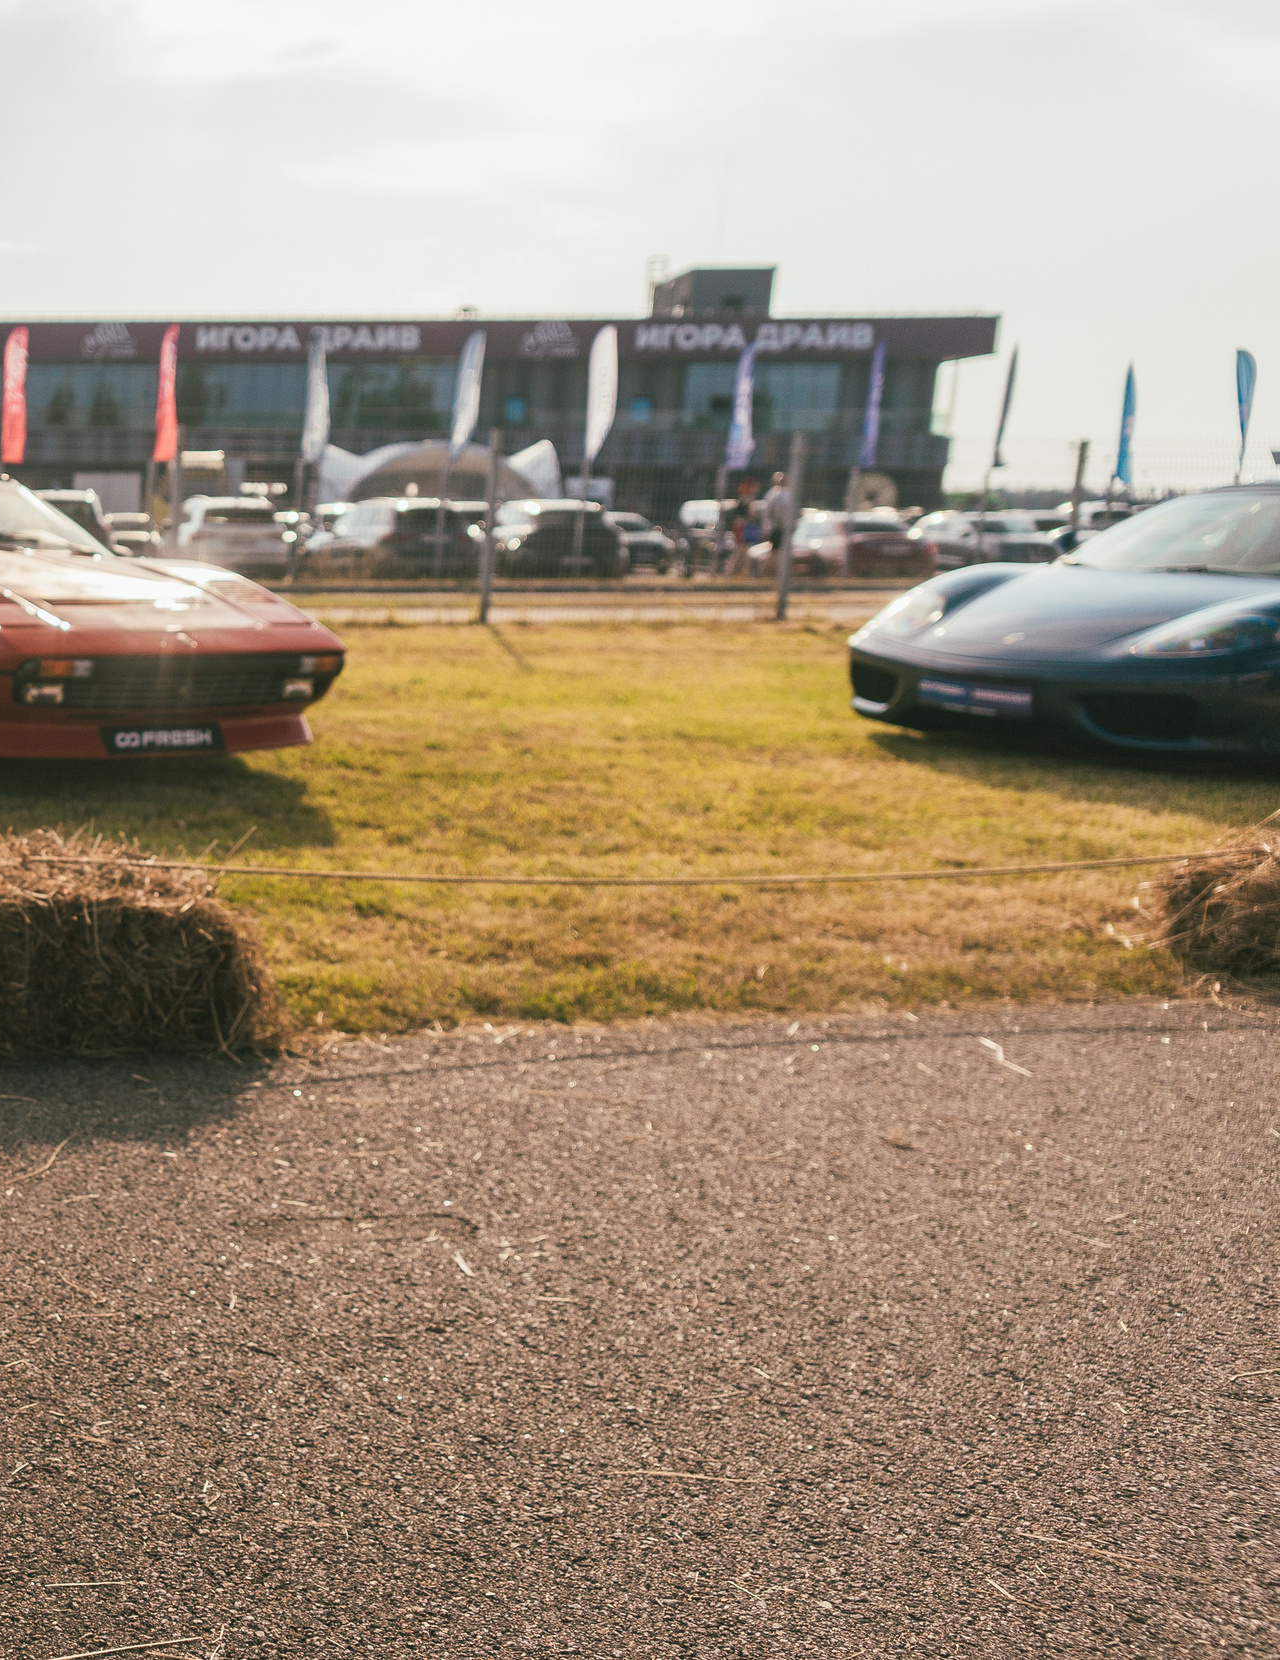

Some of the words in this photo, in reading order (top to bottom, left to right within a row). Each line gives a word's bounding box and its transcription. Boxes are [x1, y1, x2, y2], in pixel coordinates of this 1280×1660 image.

[195, 324, 301, 352] ИГОРА
[634, 322, 746, 351] ИГОРА
[142, 728, 213, 747] FRESH
